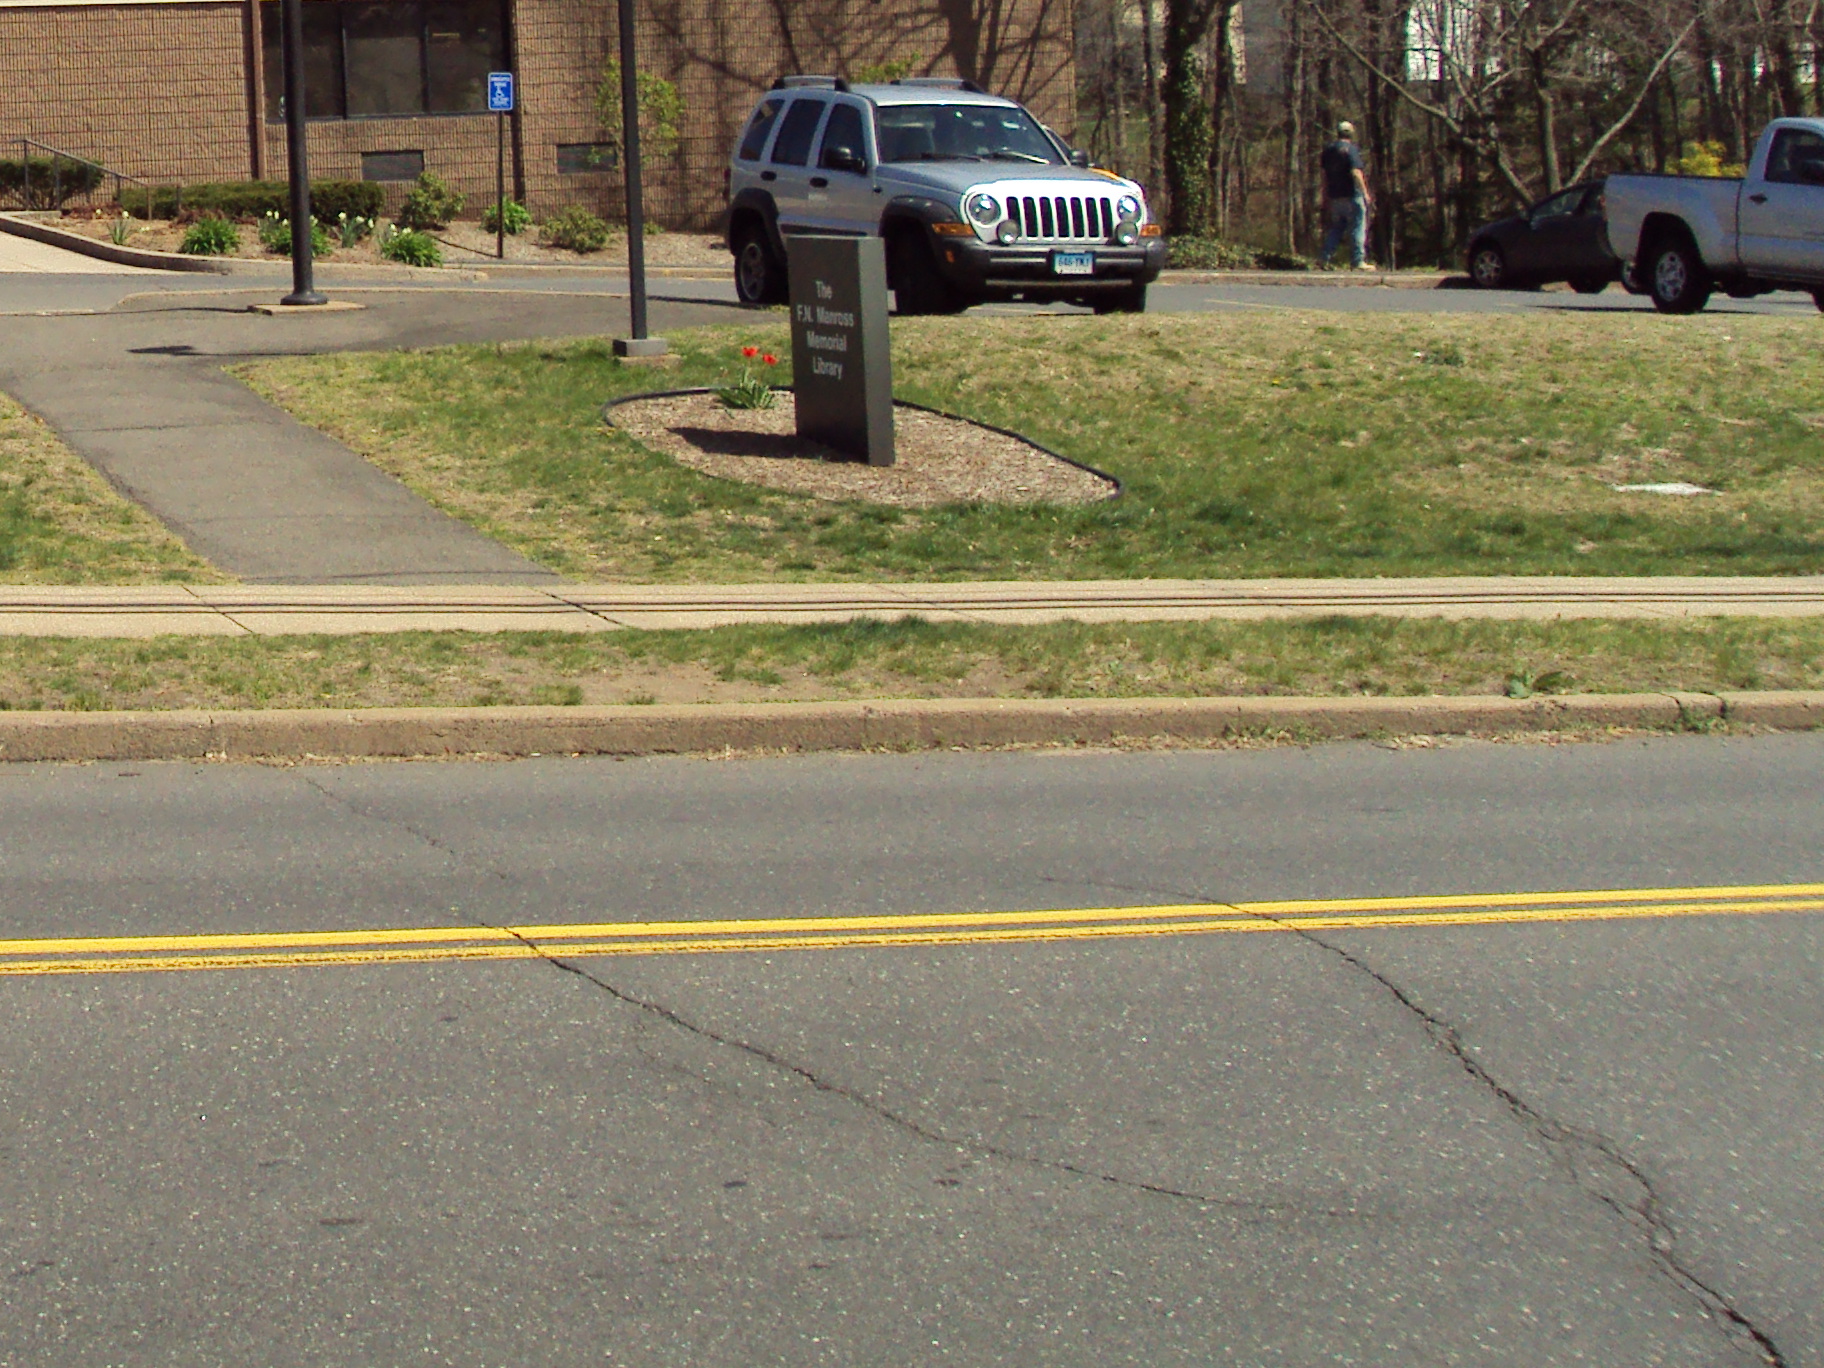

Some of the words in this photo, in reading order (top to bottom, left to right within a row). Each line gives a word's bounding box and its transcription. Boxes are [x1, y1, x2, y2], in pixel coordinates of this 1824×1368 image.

[815, 280, 833, 300] The
[816, 306, 855, 327] Manross
[806, 330, 847, 352] Memorial
[812, 356, 843, 380] Library
